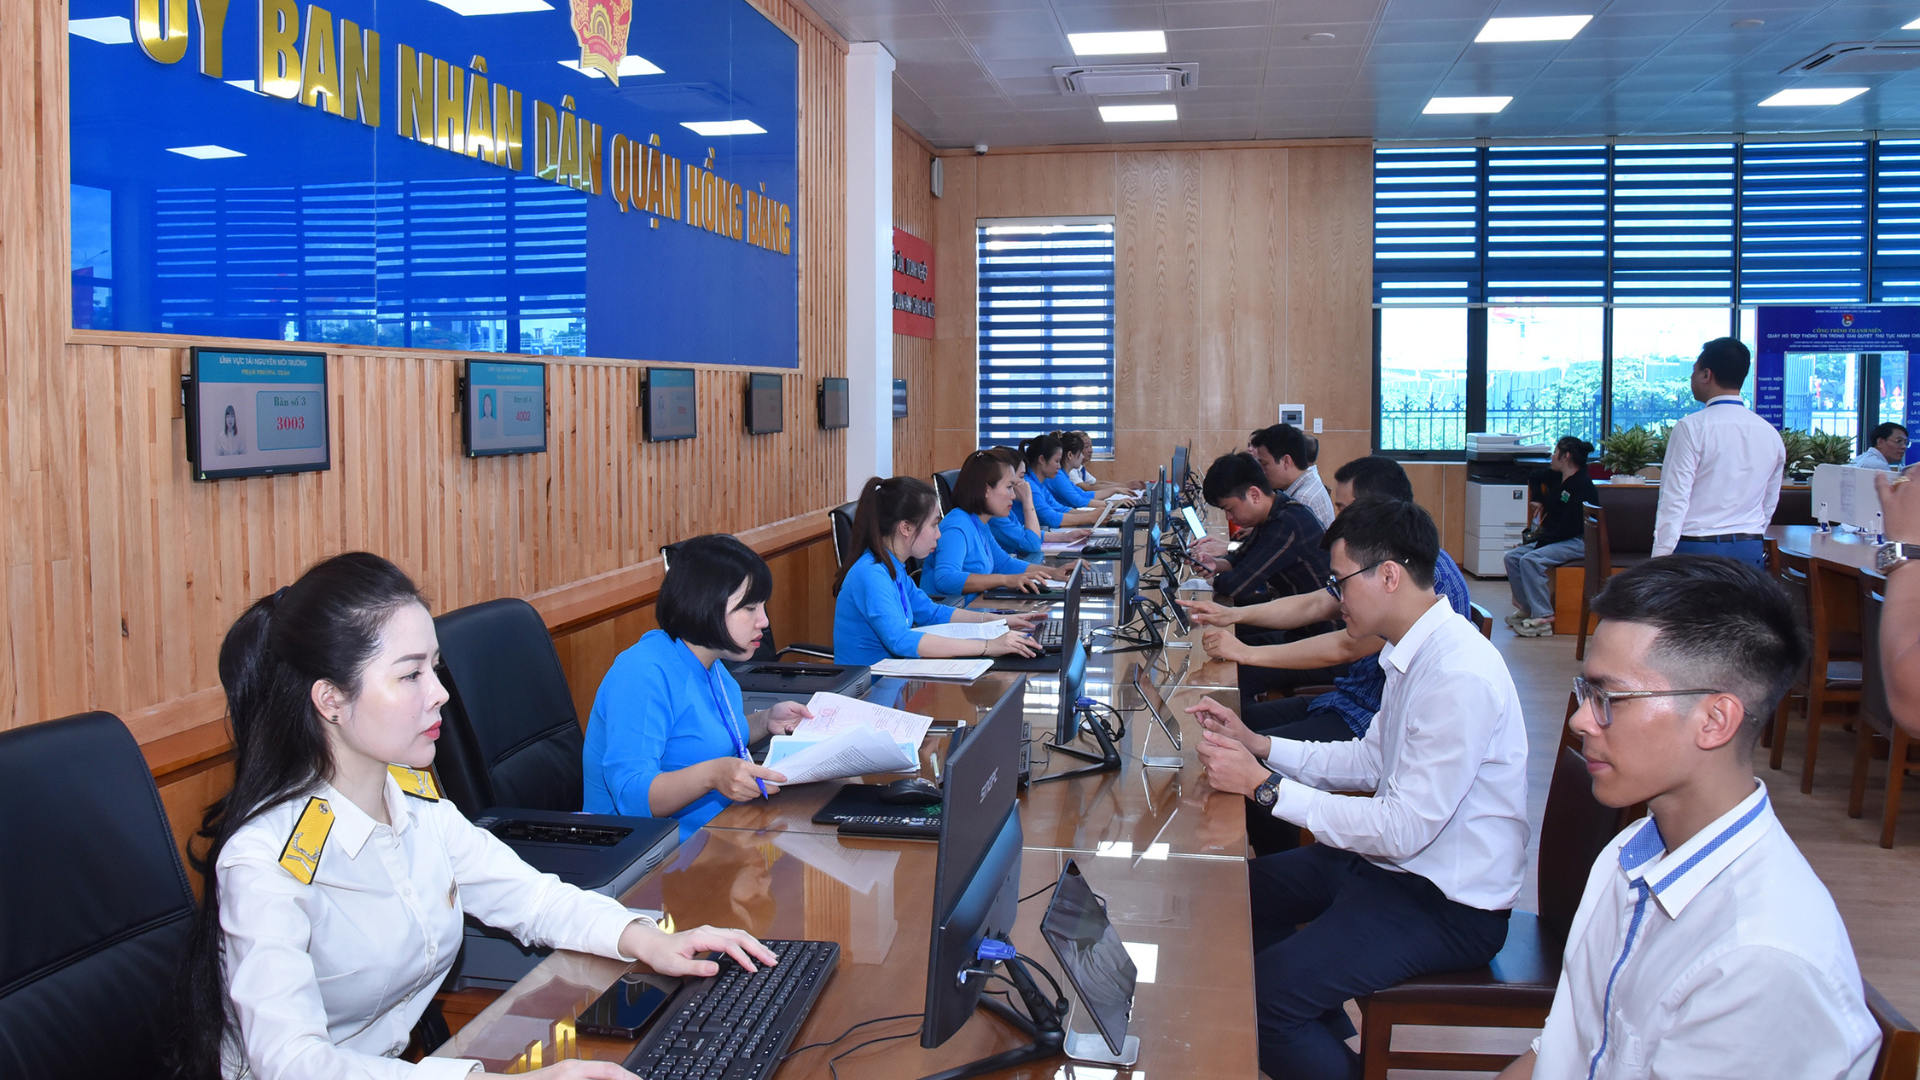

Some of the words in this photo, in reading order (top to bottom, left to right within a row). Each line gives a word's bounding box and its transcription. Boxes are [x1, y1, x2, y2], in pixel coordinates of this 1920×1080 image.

[258, 0, 380, 128] BAN
[396, 43, 522, 172] NHÂN
[533, 94, 602, 196] DÂN
[611, 133, 681, 229] QUẬN
[687, 146, 743, 241] HỒNG
[747, 182, 790, 255] BÀNG
[254, 356, 277, 366] NGUYÊN
[273, 396, 289, 407] Bàn
[291, 395, 300, 407] số
[301, 396, 307, 407] 3
[276, 416, 305, 431] 3003
